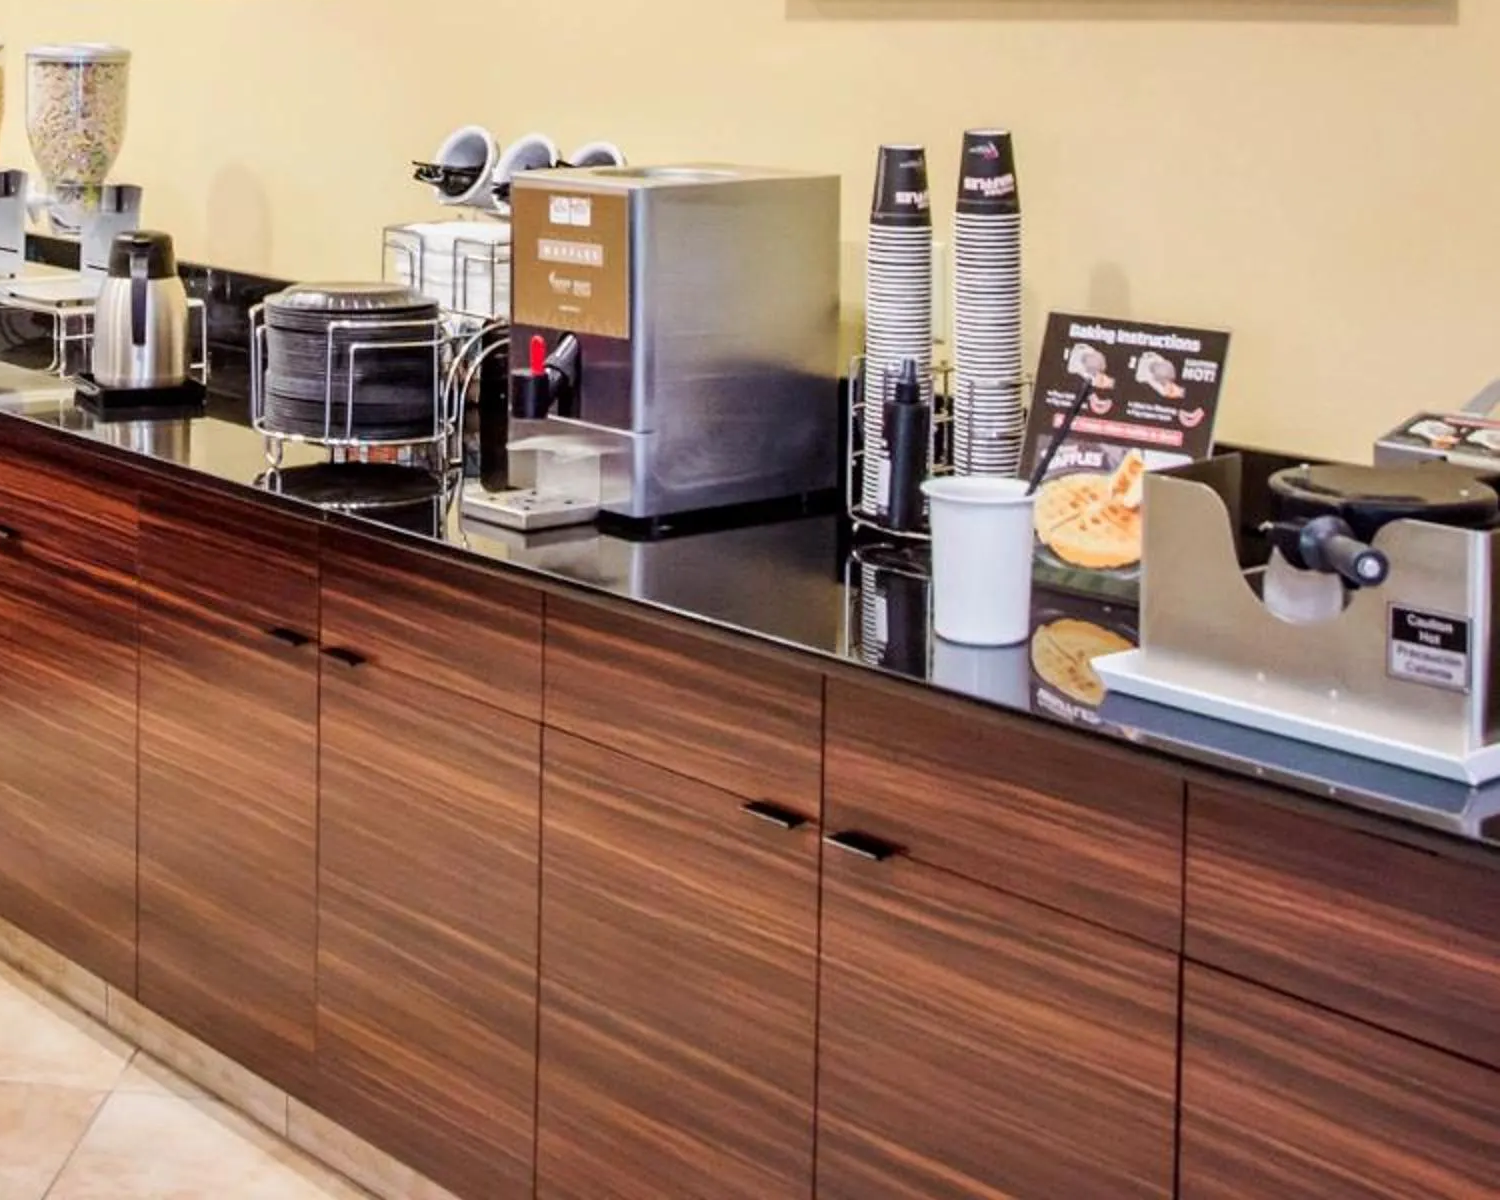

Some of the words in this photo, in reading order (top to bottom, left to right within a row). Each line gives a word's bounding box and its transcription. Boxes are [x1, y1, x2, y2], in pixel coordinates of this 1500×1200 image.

[1117, 329, 1200, 352] Instructions
[1406, 613, 1454, 634] Caution
[1418, 630, 1441, 645] Hot
